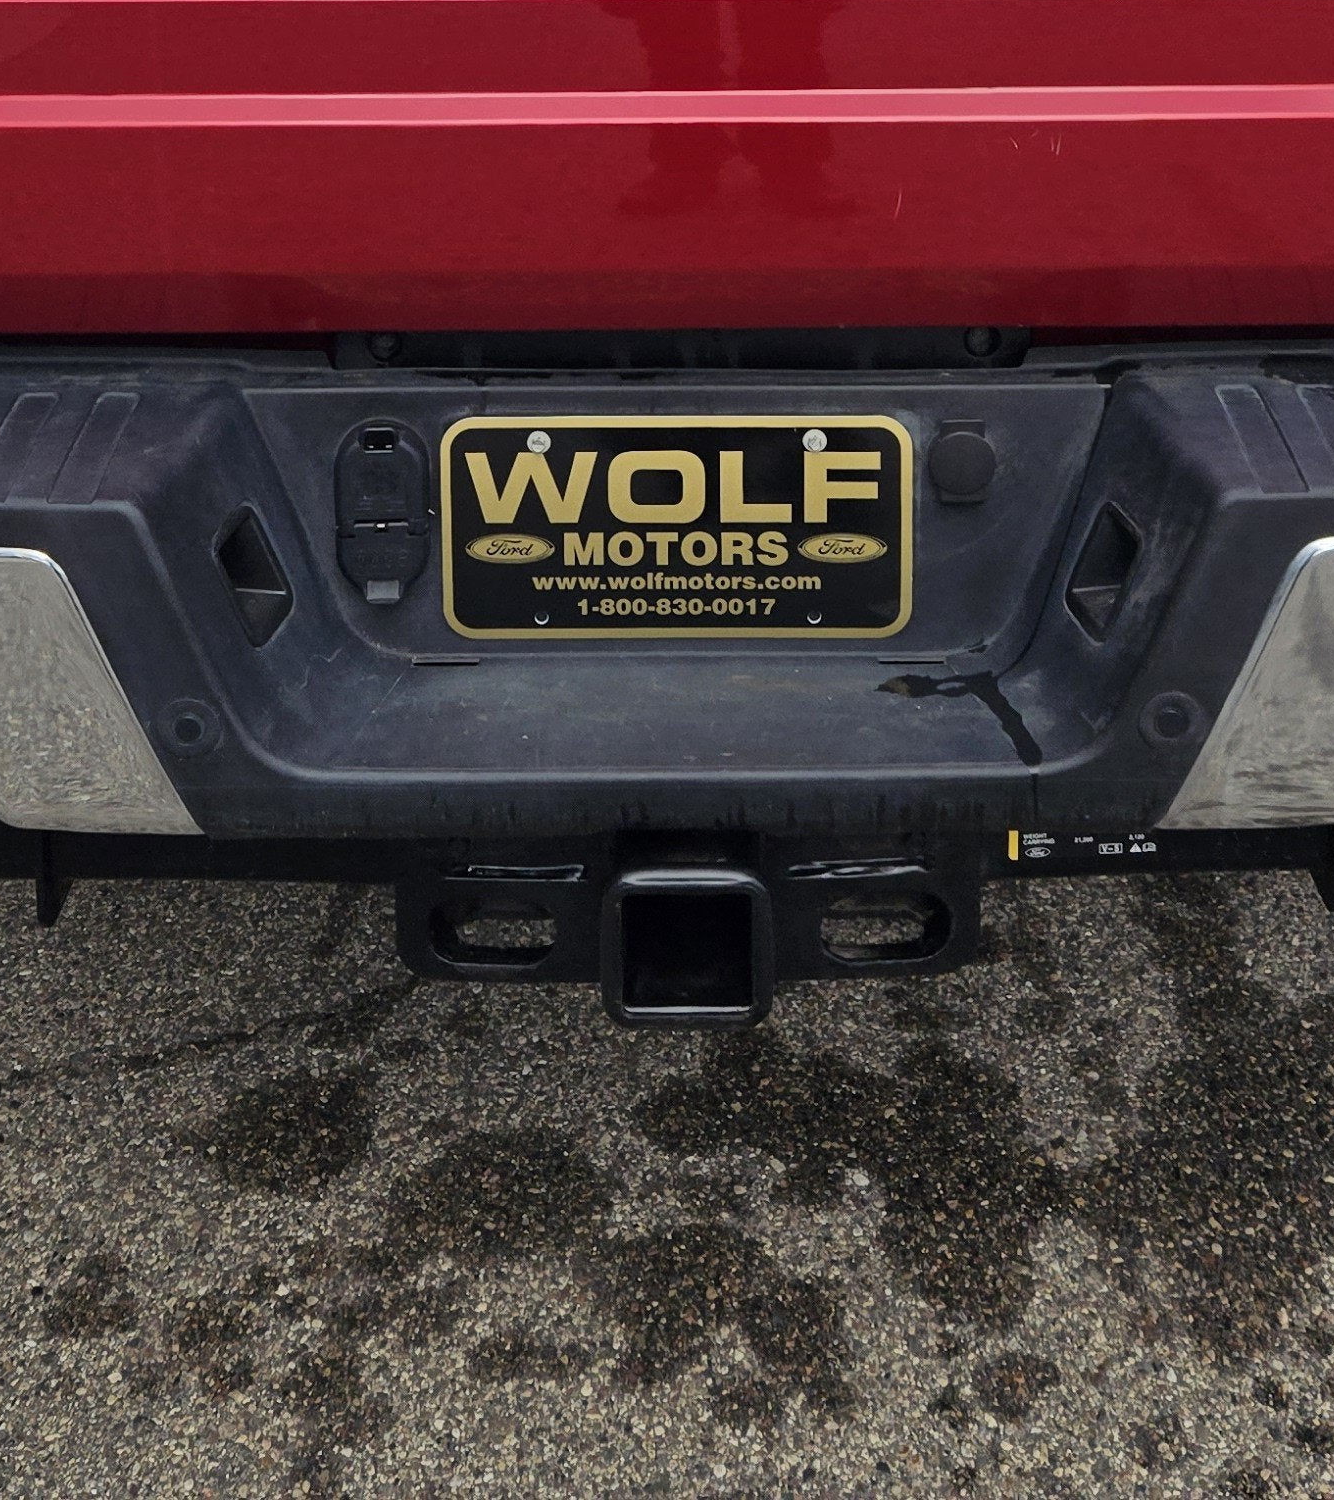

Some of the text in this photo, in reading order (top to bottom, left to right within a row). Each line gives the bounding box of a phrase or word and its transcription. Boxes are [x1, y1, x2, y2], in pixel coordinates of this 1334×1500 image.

[465, 450, 882, 525] WOLF
[563, 531, 790, 567] MOTORS
[532, 572, 822, 591] www.wolfmotors.com
[577, 598, 777, 616] 1-800-830-0017
